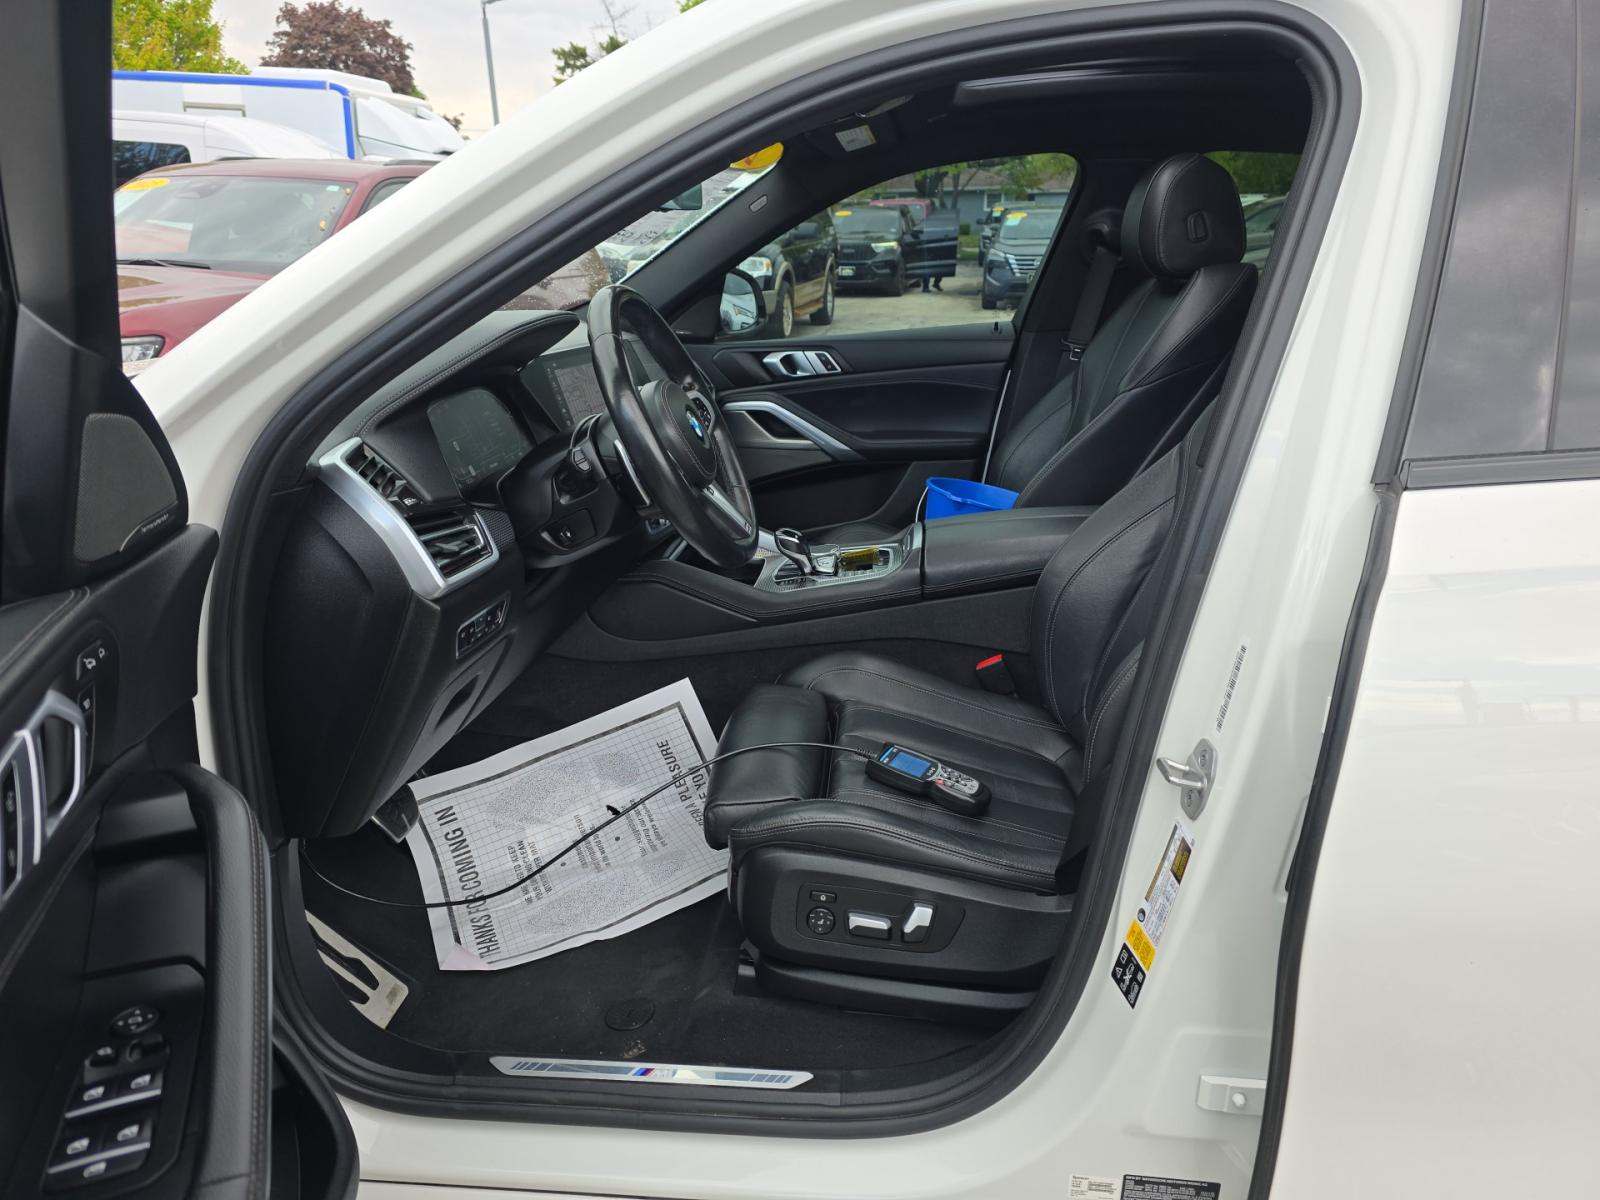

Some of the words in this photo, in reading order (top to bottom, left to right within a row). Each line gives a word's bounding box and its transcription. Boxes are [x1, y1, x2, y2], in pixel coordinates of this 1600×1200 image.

[655, 738, 692, 802] PLEASURE
[433, 804, 457, 827] IN
[442, 826, 482, 892] COMING
[469, 912, 501, 959] THANKS
